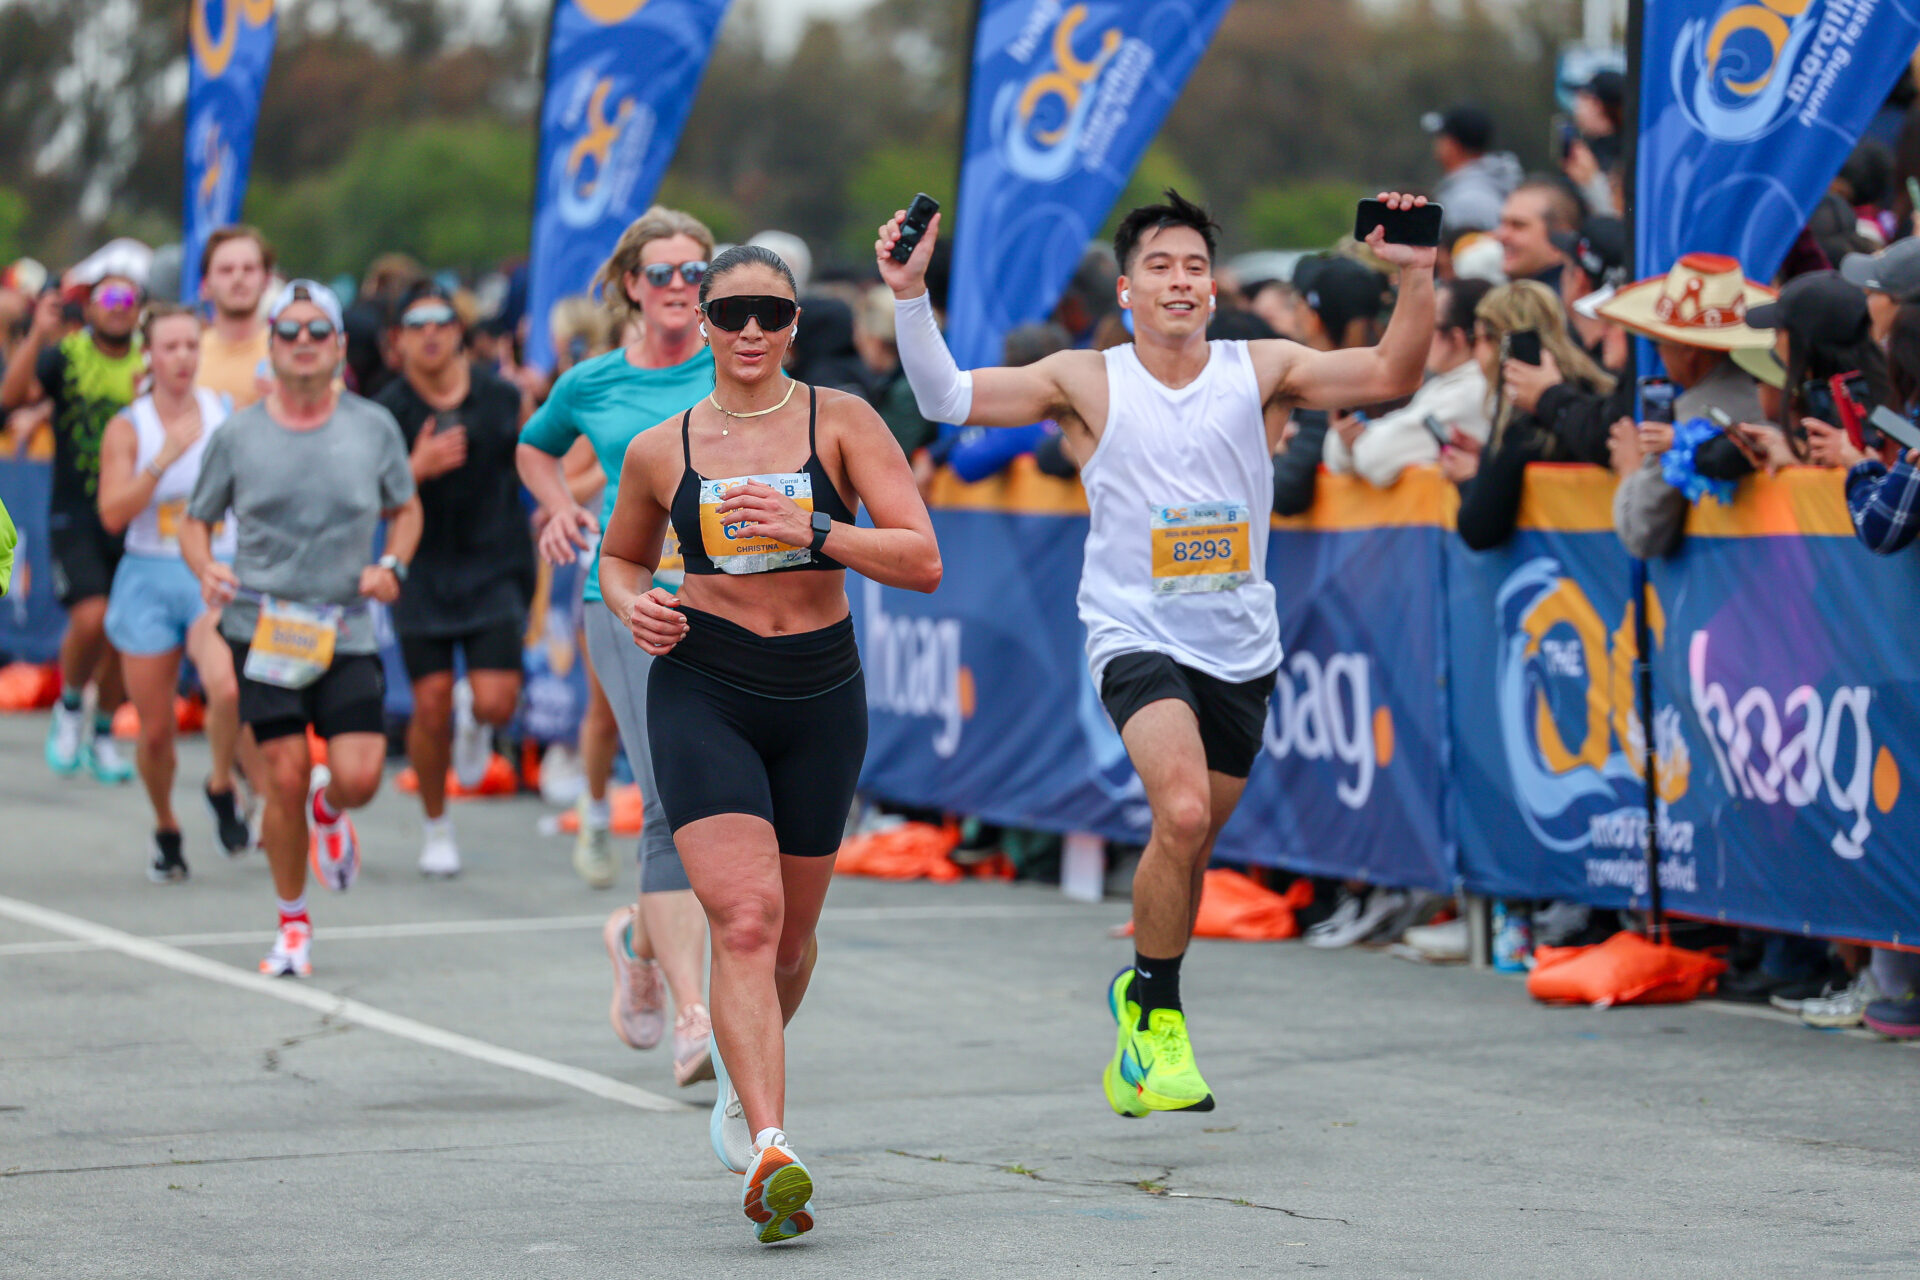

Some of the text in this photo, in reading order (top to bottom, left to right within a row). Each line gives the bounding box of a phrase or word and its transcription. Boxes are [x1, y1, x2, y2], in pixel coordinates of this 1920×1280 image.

[1798, 46, 1851, 127] running
[779, 478, 799, 486] Corral
[784, 485, 795, 497] B
[1228, 510, 1237, 521] B
[736, 543, 779, 553] CHRISTINA
[1173, 538, 1232, 562] 8293
[1262, 650, 1376, 810] oag
